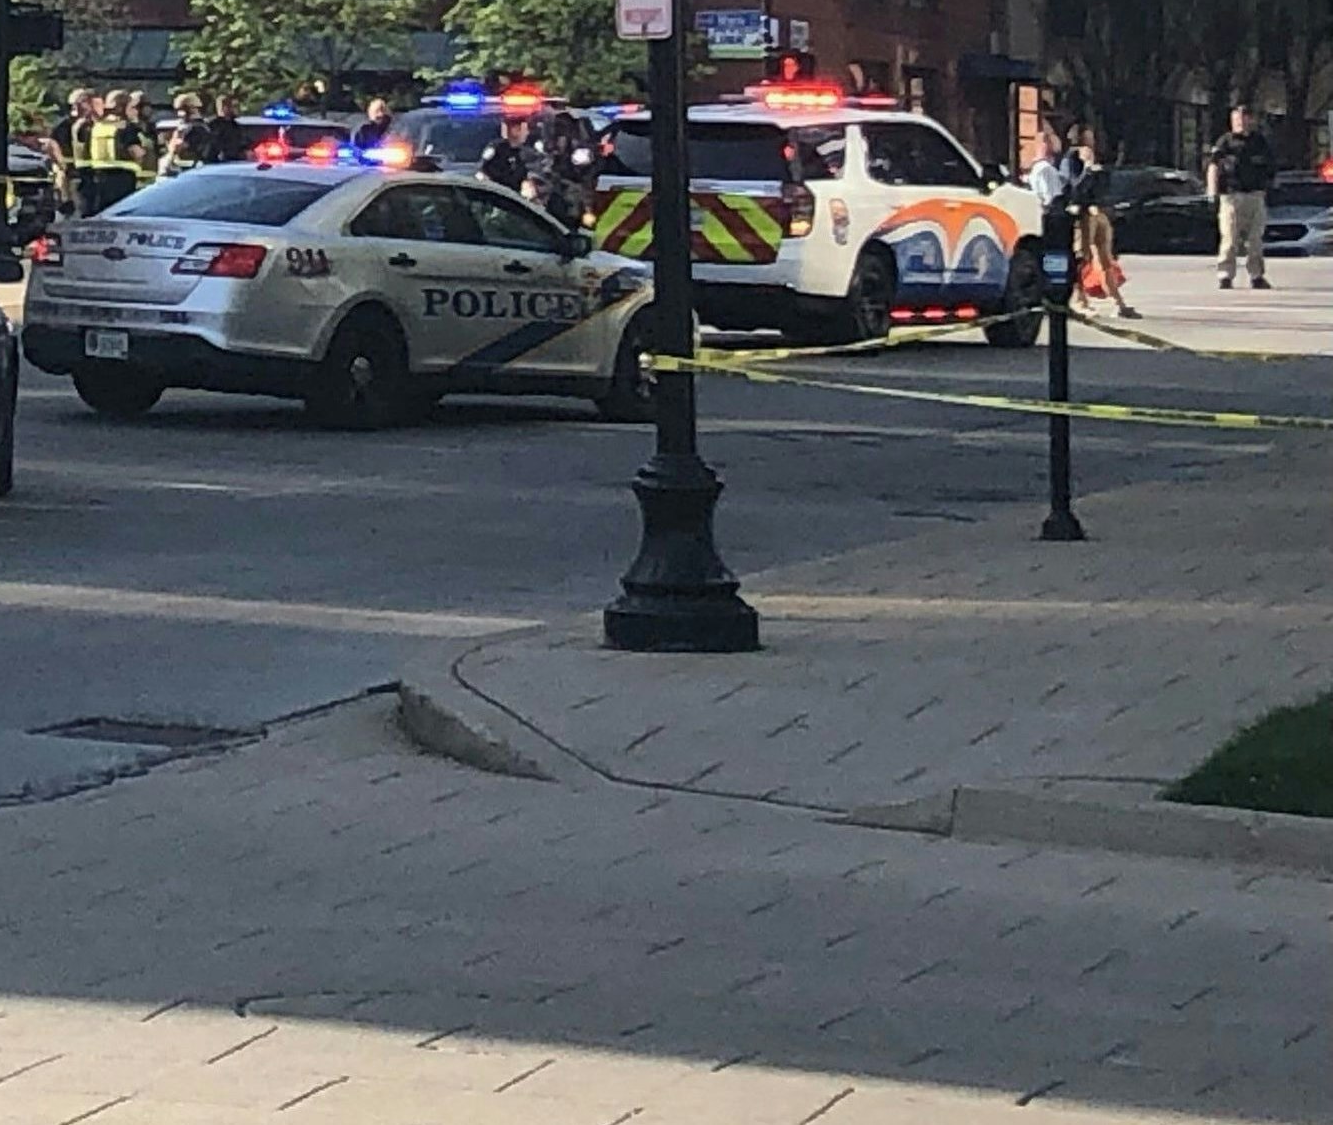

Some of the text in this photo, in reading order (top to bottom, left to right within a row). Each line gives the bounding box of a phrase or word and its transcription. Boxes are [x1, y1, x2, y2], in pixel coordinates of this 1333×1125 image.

[126, 231, 187, 250] POLICE
[286, 248, 331, 276] 911
[421, 287, 584, 322] POLICE
